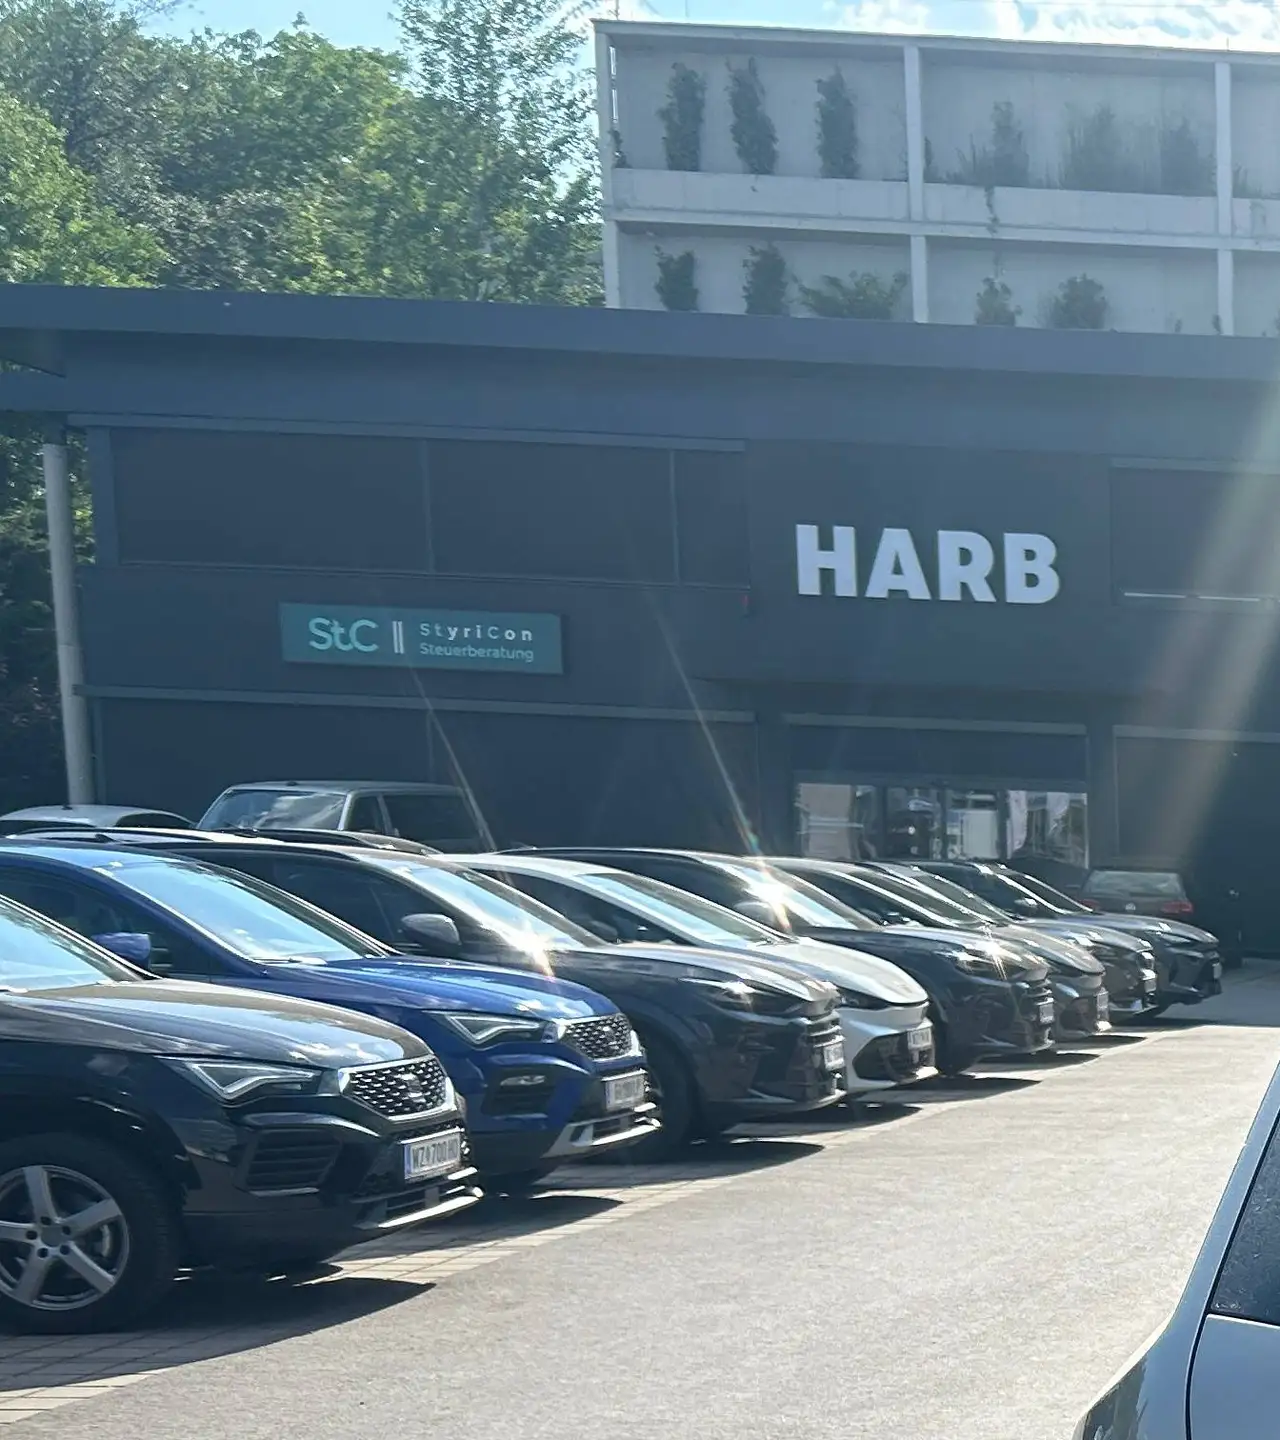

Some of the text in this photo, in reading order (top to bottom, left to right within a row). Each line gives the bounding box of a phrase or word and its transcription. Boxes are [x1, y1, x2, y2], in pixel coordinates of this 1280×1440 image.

[796, 524, 1060, 604] HARB
[308, 617, 379, 652] StC
[420, 623, 533, 641] StyriCon
[420, 643, 534, 662] Steuerberatung
